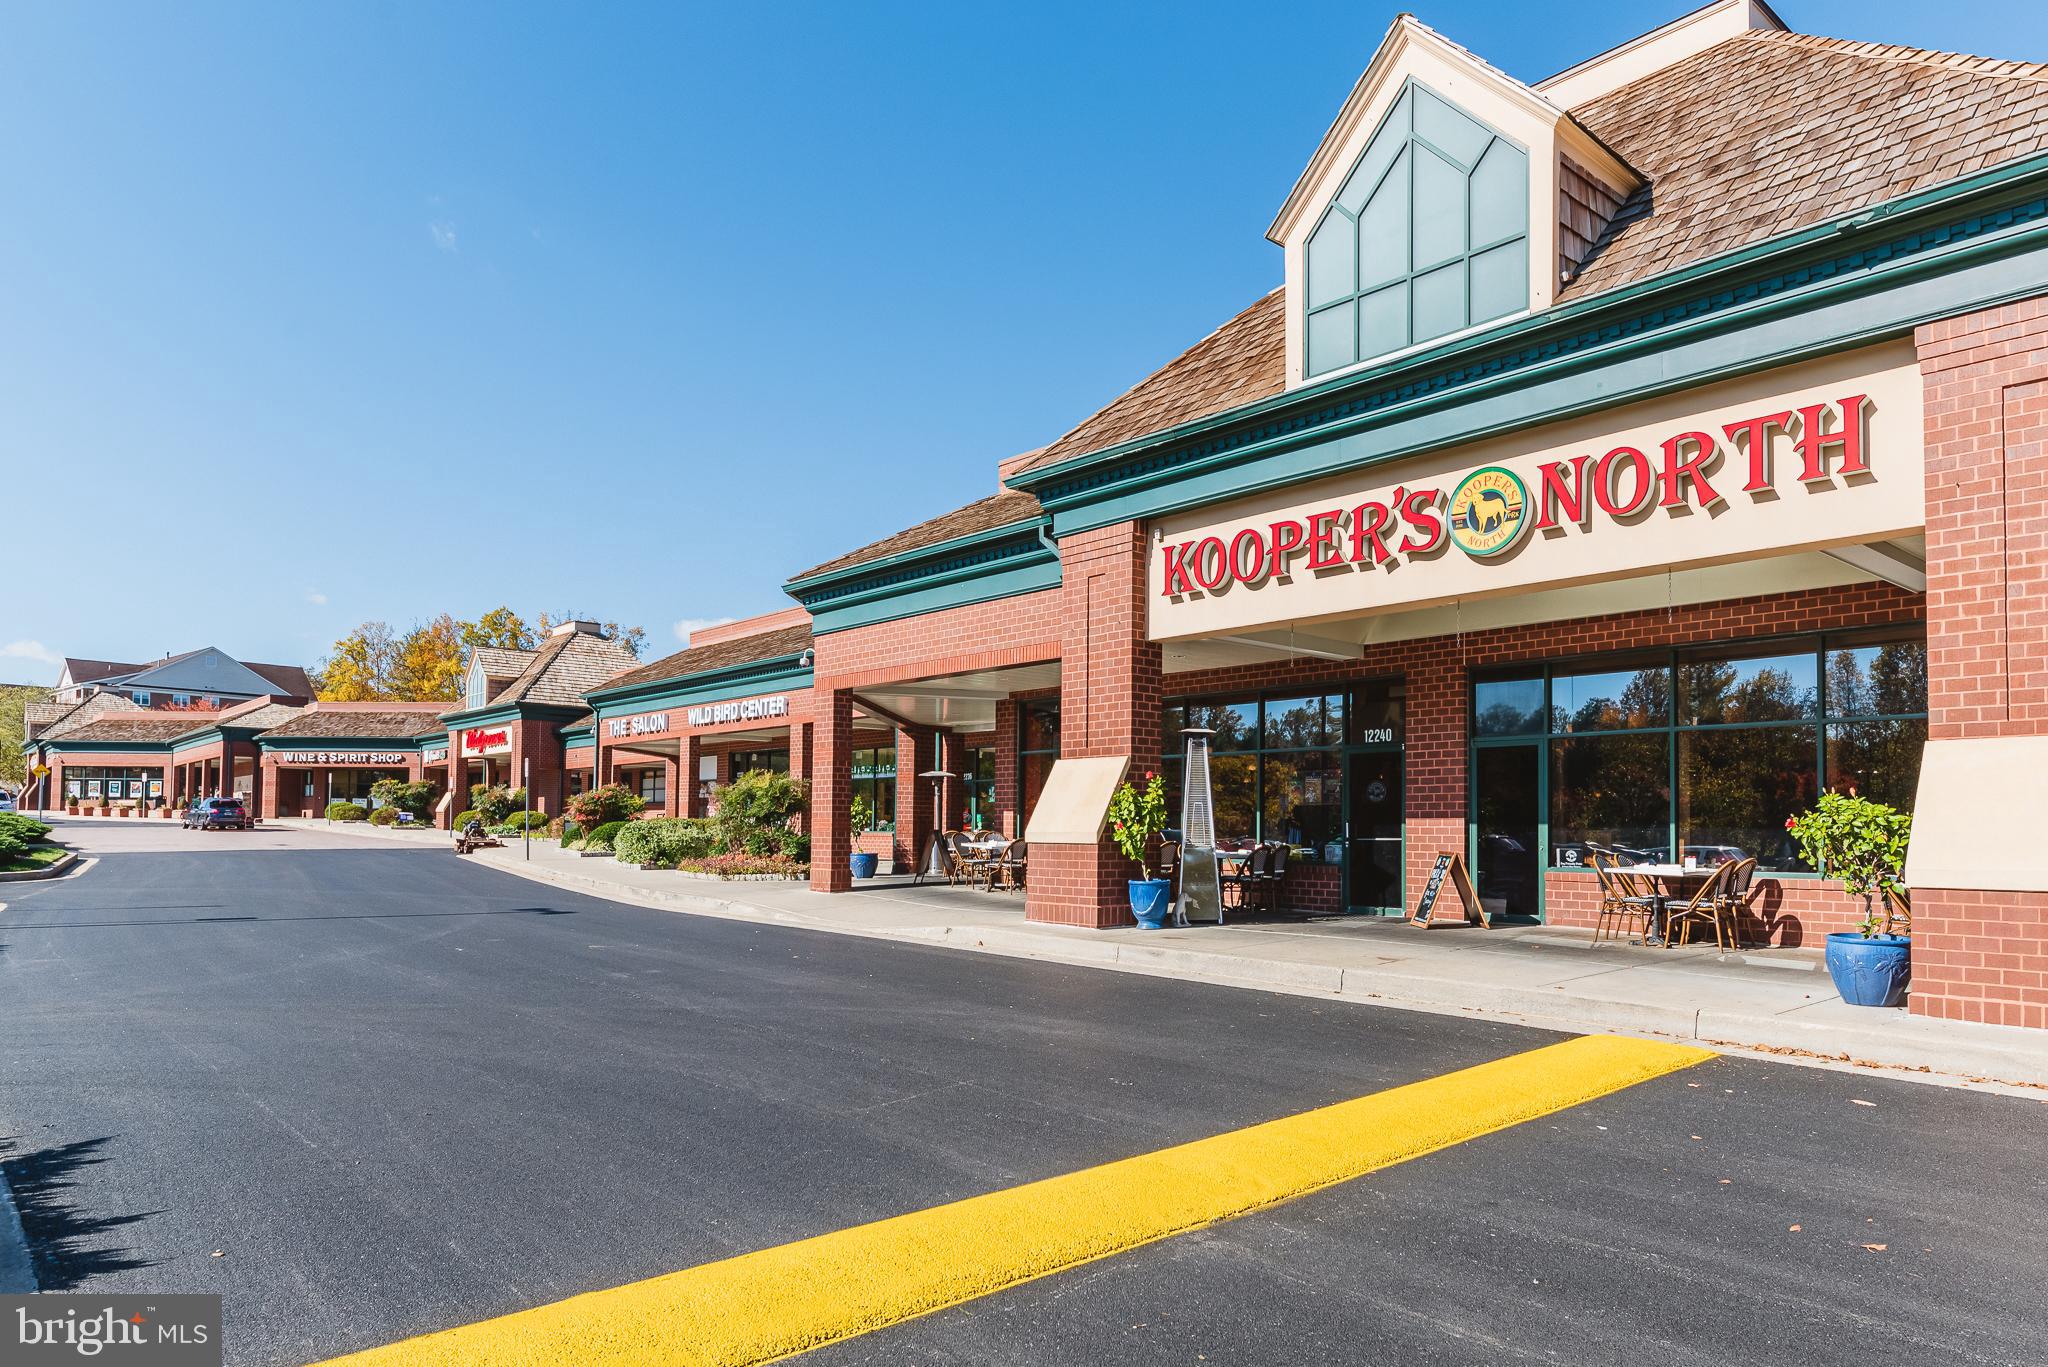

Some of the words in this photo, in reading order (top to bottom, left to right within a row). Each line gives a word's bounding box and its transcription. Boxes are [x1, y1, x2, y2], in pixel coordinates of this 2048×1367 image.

[1162, 486, 1446, 597] KOOPER'S
[1535, 394, 1870, 531] NORTH
[1467, 530, 1506, 548] NORTH
[688, 708, 712, 725] WILD
[713, 702, 739, 721] BIRD
[740, 696, 787, 717] CENTER
[609, 720, 627, 736] THE
[632, 714, 667, 733] SALON
[1364, 728, 1392, 743] 12240
[283, 752, 315, 762] WINE
[317, 752, 327, 762] &
[329, 752, 368, 762] SPIRIT
[370, 753, 402, 762] SHOP
